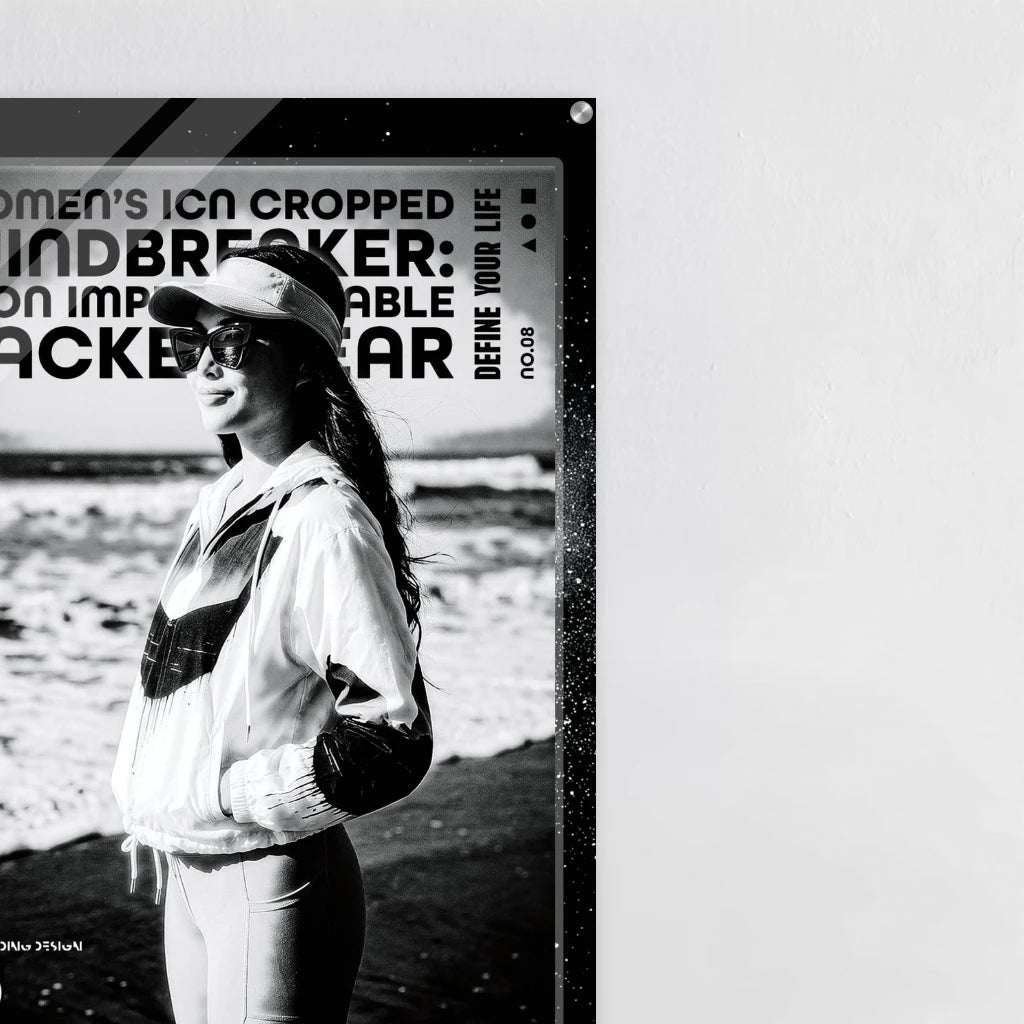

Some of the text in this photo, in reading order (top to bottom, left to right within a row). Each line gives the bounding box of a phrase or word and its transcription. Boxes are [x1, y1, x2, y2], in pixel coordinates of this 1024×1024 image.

[249, 188, 454, 220] CROPPED
[474, 188, 501, 380] DEFINE YOUR LIFE
